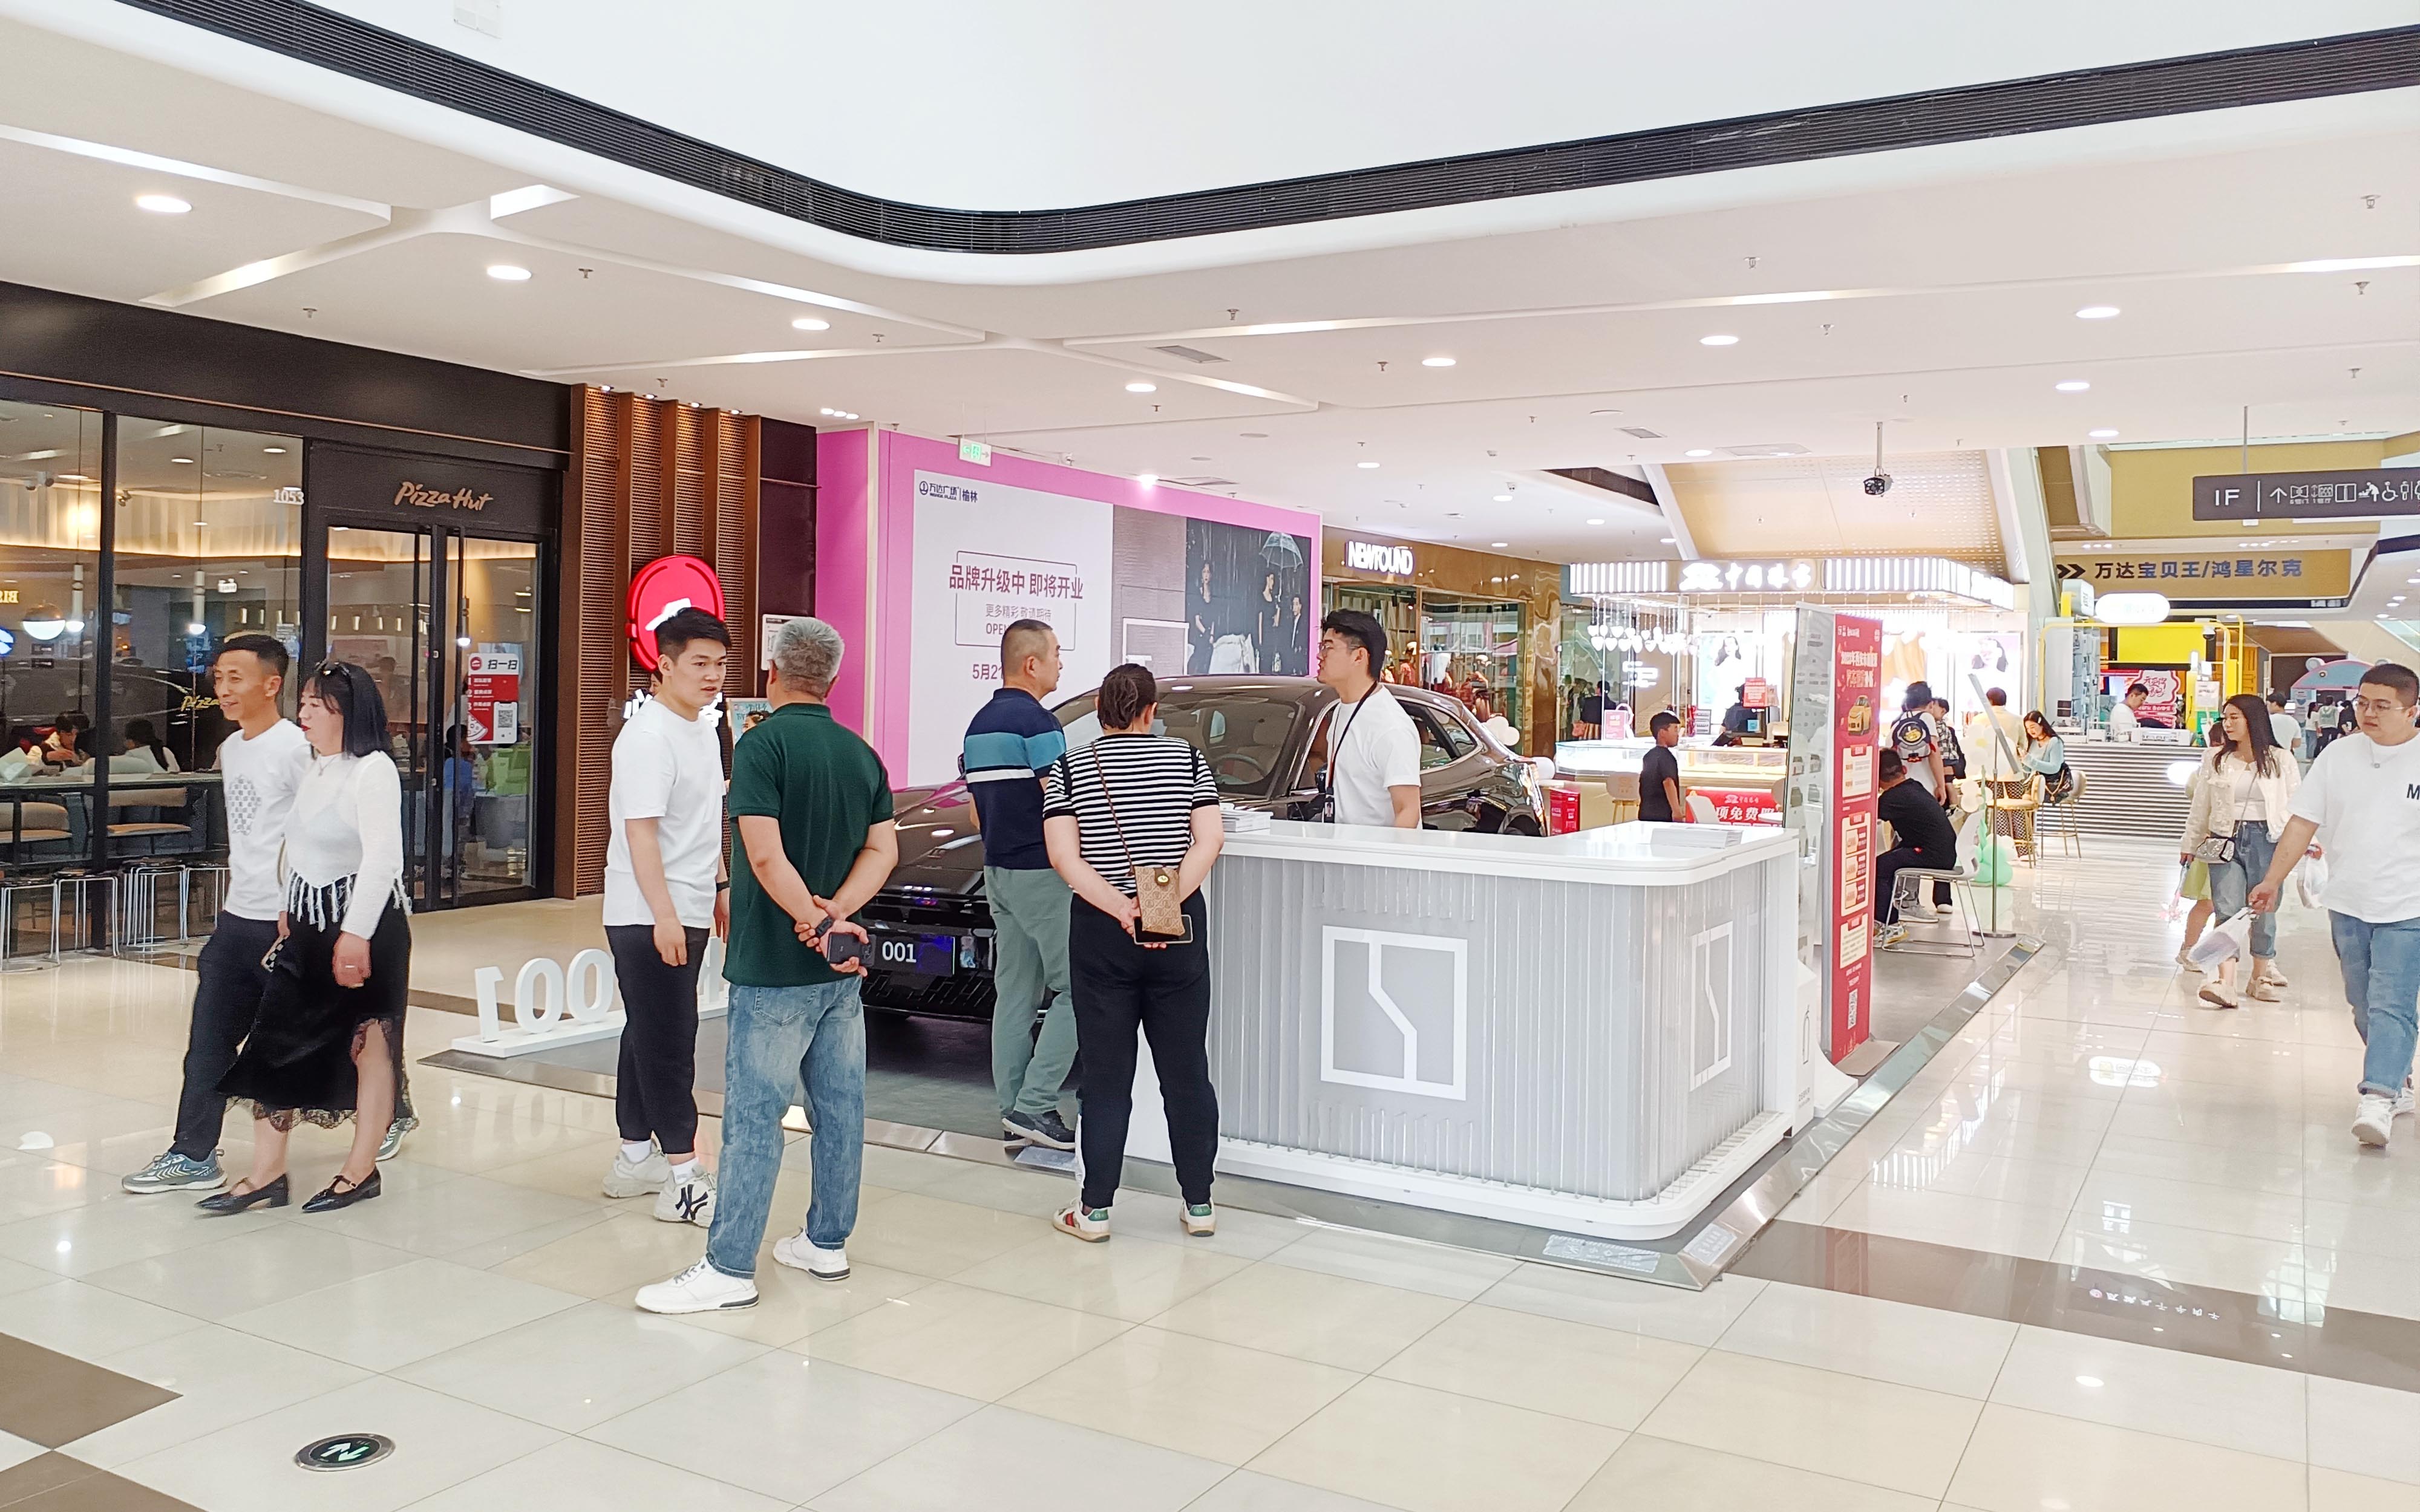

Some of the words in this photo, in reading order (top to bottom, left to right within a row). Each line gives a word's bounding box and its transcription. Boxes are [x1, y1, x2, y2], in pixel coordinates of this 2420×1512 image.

[273, 488, 304, 505] 1053
[394, 481, 451, 507] Pizza
[453, 487, 494, 511] Hut
[929, 483, 957, 496] 万达广场
[962, 489, 978, 503] 榆林
[2094, 559, 2303, 579] 万达宝贝王/鸿星尔克
[949, 564, 1025, 595] 品牌升级中
[1029, 573, 1084, 600] 即将开业
[985, 604, 1019, 619] 更多精彩
[1020, 606, 1052, 622] 敬请期待
[488, 659, 518, 670] 扫一扫
[882, 941, 917, 963] 001
